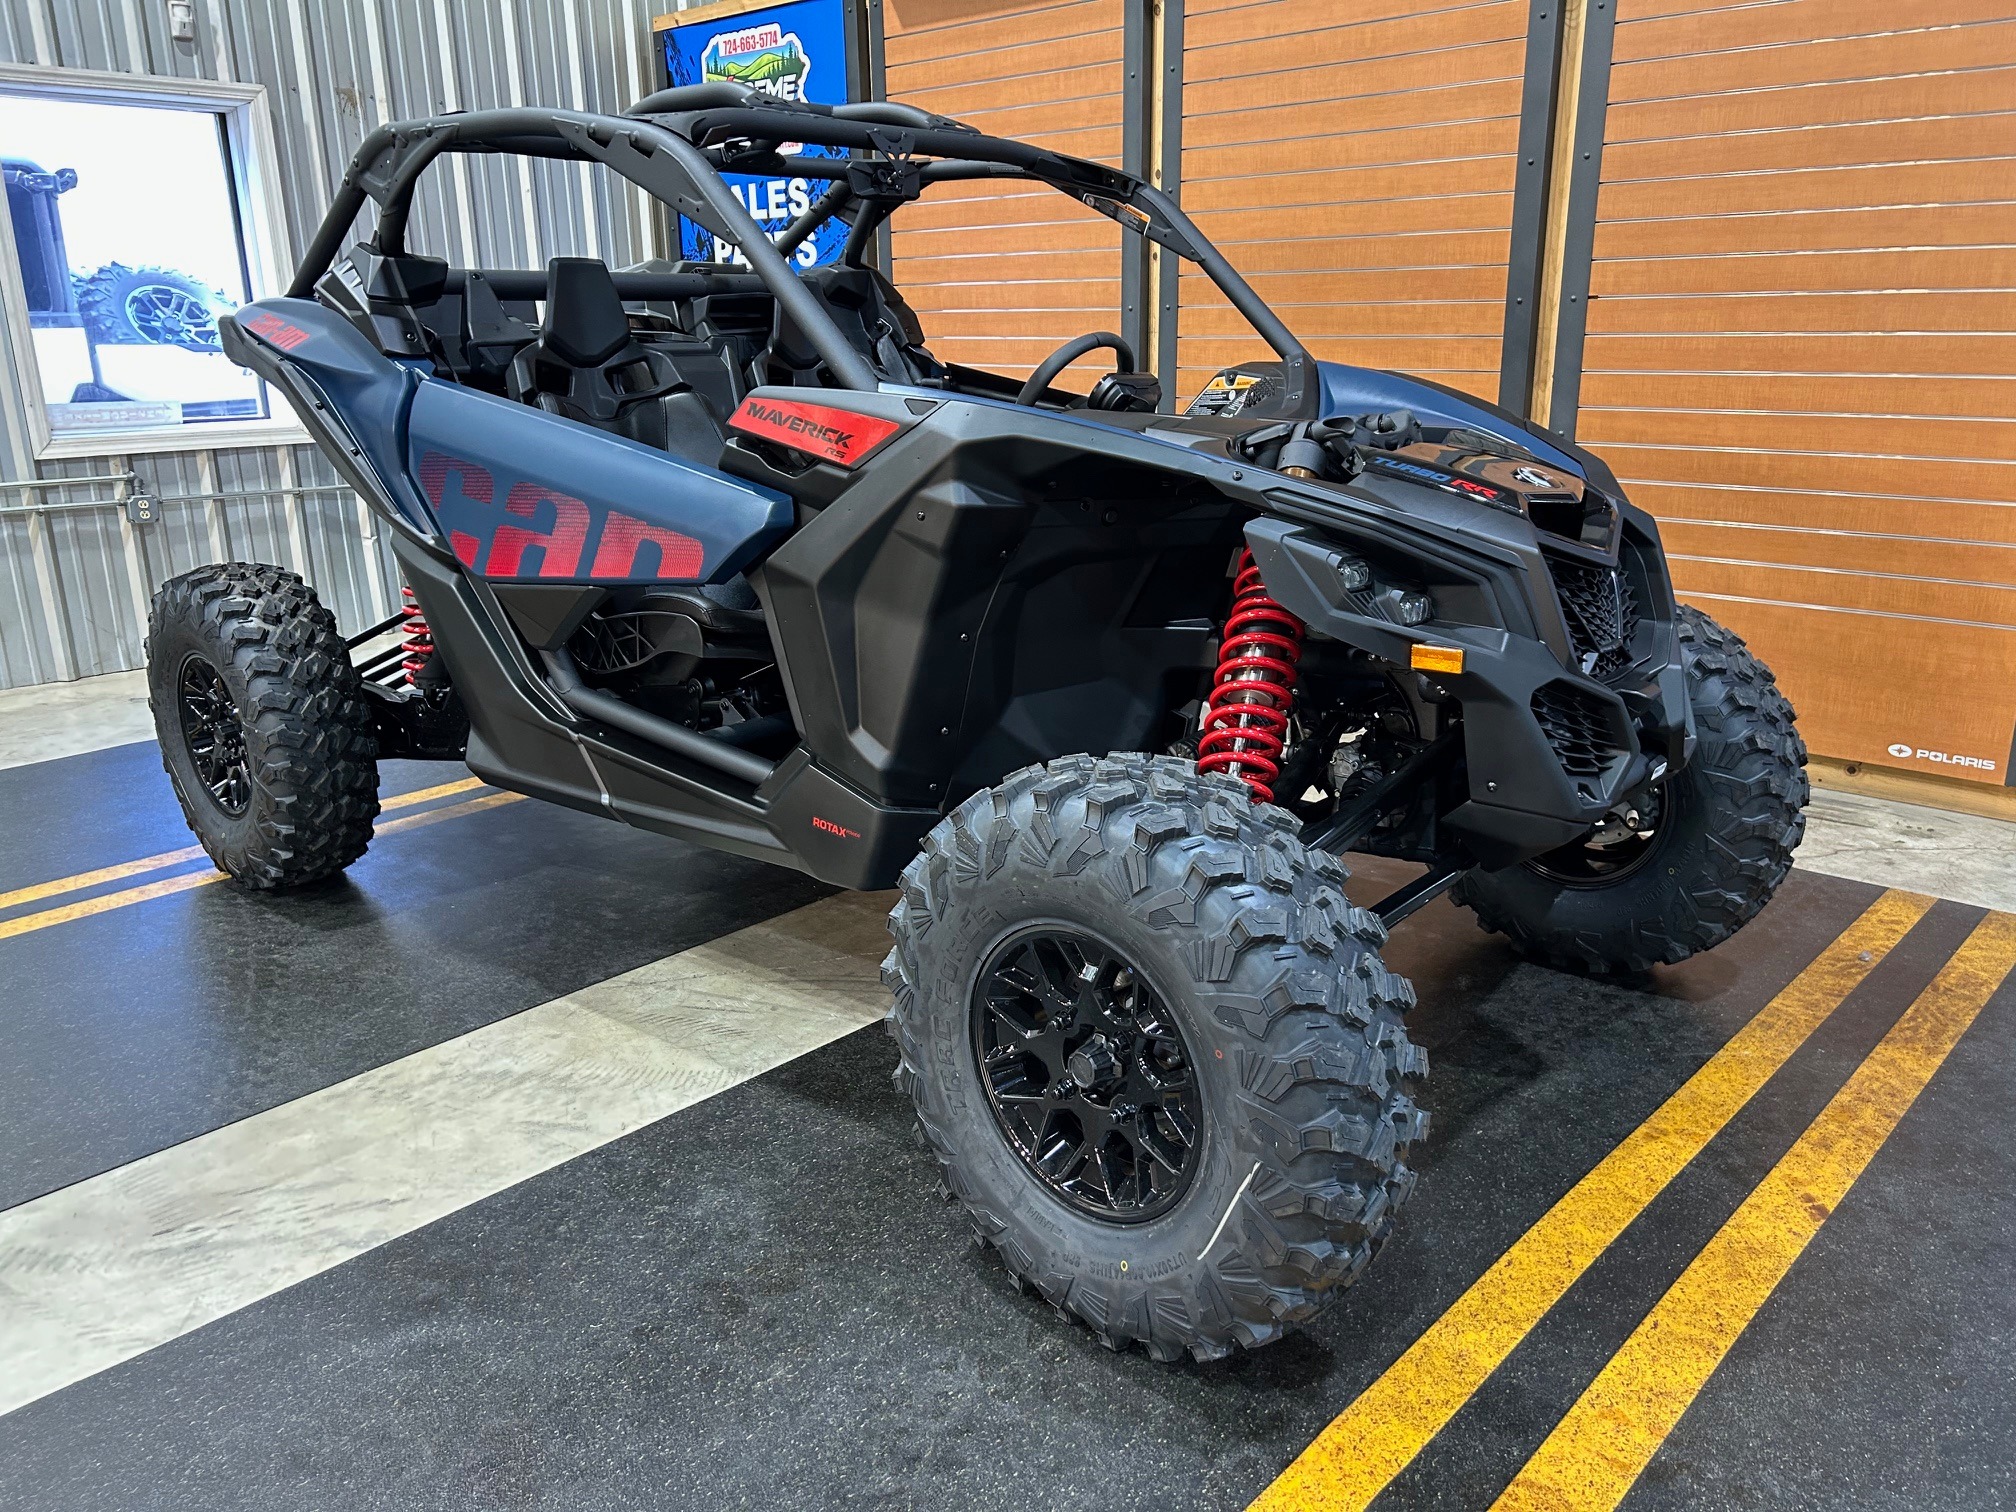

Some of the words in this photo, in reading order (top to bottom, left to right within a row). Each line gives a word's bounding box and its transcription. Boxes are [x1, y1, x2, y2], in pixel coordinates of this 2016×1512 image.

[722, 30, 779, 55] 724-663-5774
[746, 401, 854, 449] MAVERICK
[824, 446, 847, 459] RS
[1374, 456, 1451, 482] TURBO
[1450, 478, 1499, 499] RR
[1915, 748, 1996, 770] POLARIS
[812, 816, 847, 838] ROTAX
